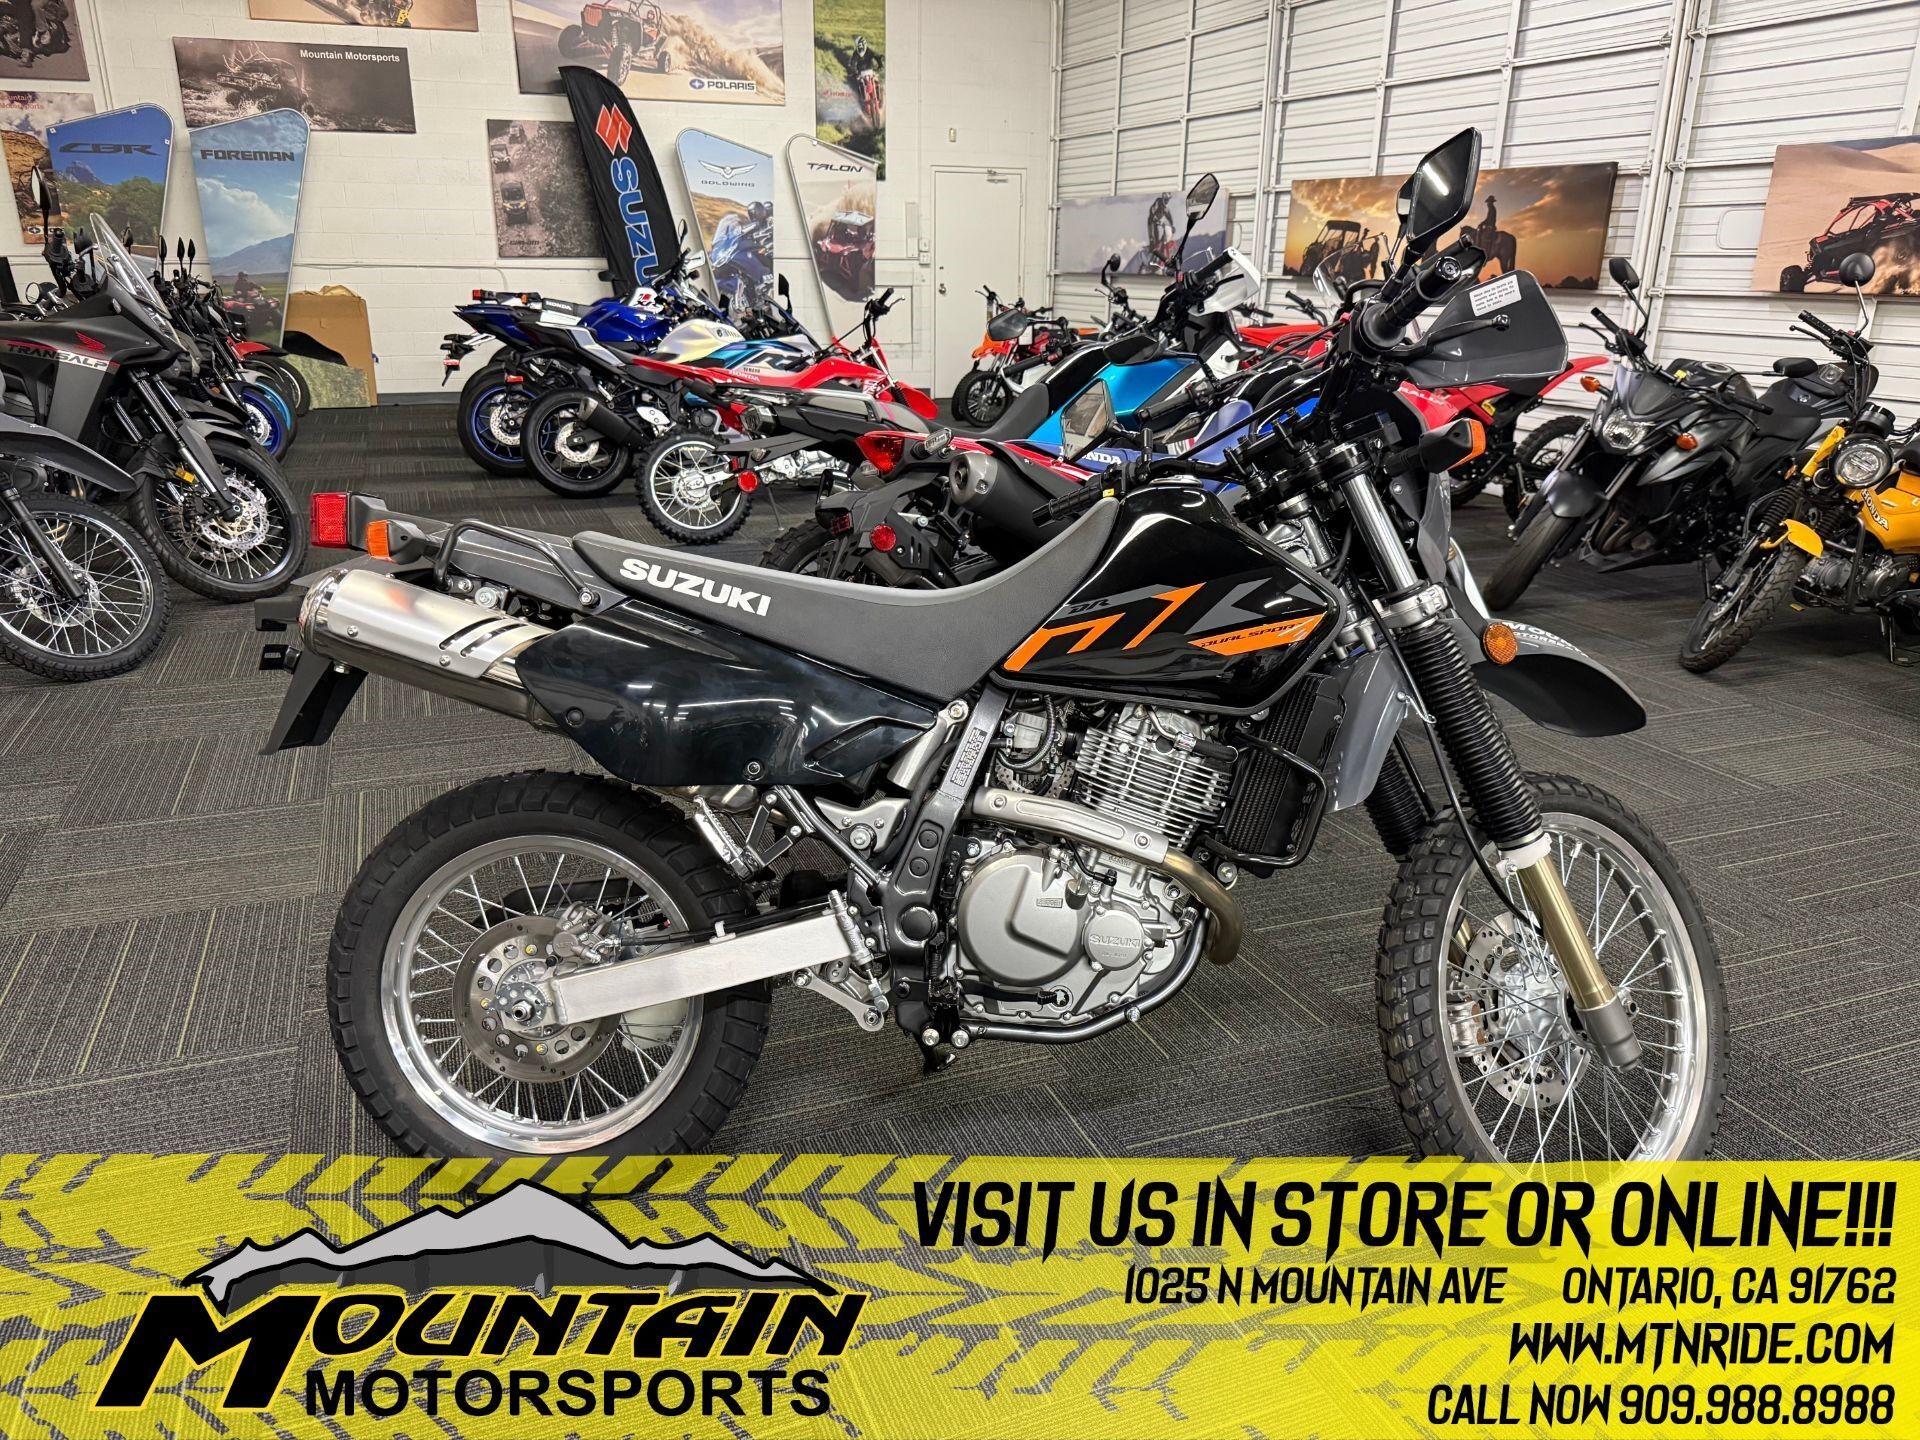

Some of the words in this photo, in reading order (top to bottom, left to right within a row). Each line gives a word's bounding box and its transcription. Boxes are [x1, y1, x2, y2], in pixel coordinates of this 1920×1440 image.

[299, 49, 343, 60] Mountain
[345, 51, 400, 63] Motorsports
[706, 80, 756, 91] POLARIS
[59, 142, 161, 157] CBR
[200, 149, 296, 162] FOREMAN
[807, 162, 864, 173] TALON
[701, 180, 755, 188] GOLDWING
[545, 300, 574, 312] HONDA
[7, 343, 109, 369] TRANSALP
[1861, 488, 1889, 531] HONDA
[618, 557, 773, 618] SUZUKI
[1200, 633, 1247, 649] DUAL
[1089, 933, 1141, 949] SUZUKI
